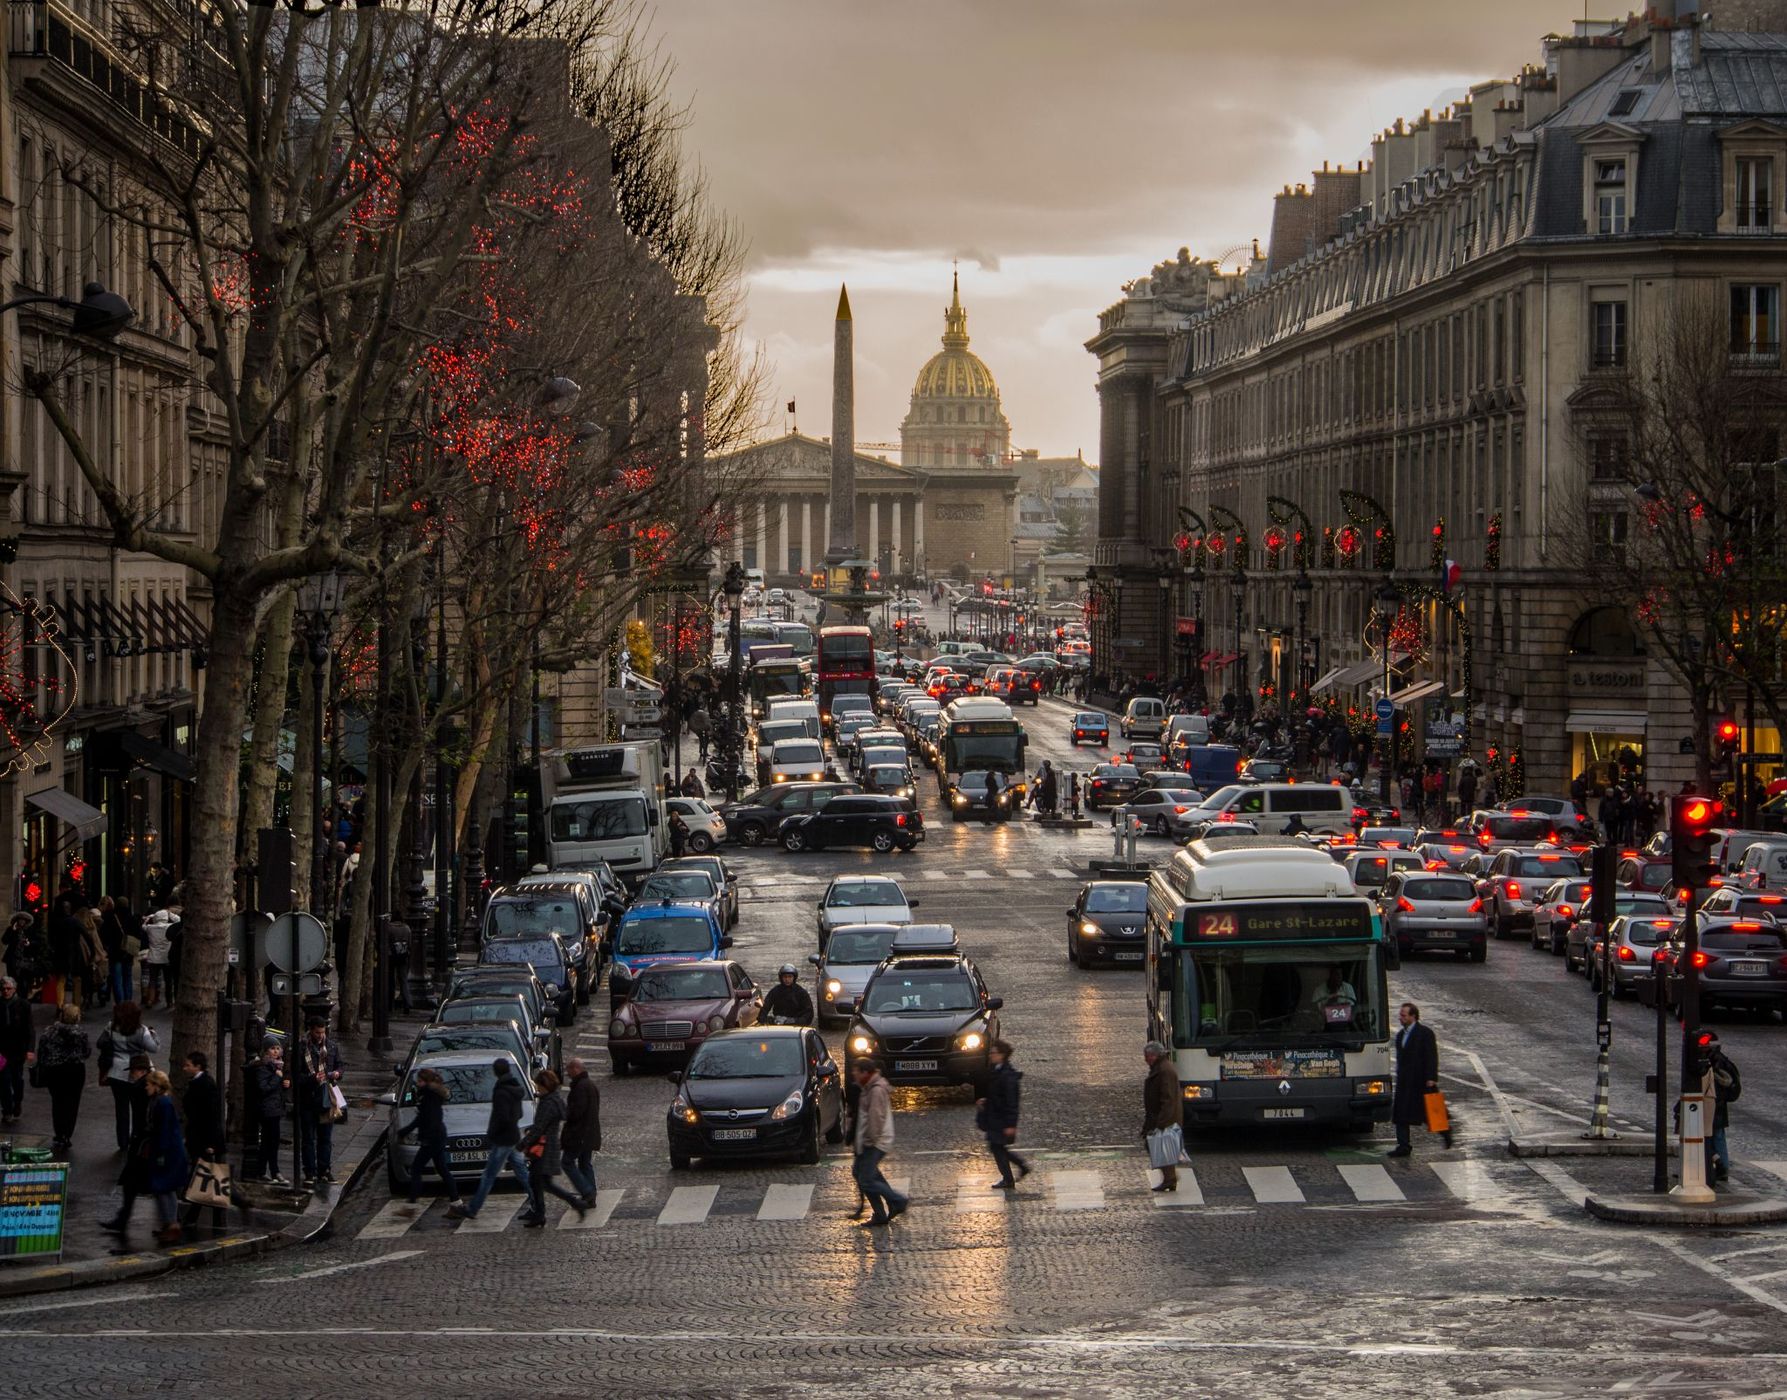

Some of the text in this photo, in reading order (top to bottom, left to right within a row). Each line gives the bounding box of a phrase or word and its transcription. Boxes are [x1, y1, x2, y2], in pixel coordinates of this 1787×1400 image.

[580, 753, 609, 761] CARRIER
[1205, 915, 1359, 935] 24 Gare St-Lazare
[1331, 1008, 1346, 1018] 24
[1311, 1059, 1322, 1067] Van
[1273, 1108, 1295, 1118] 7044
